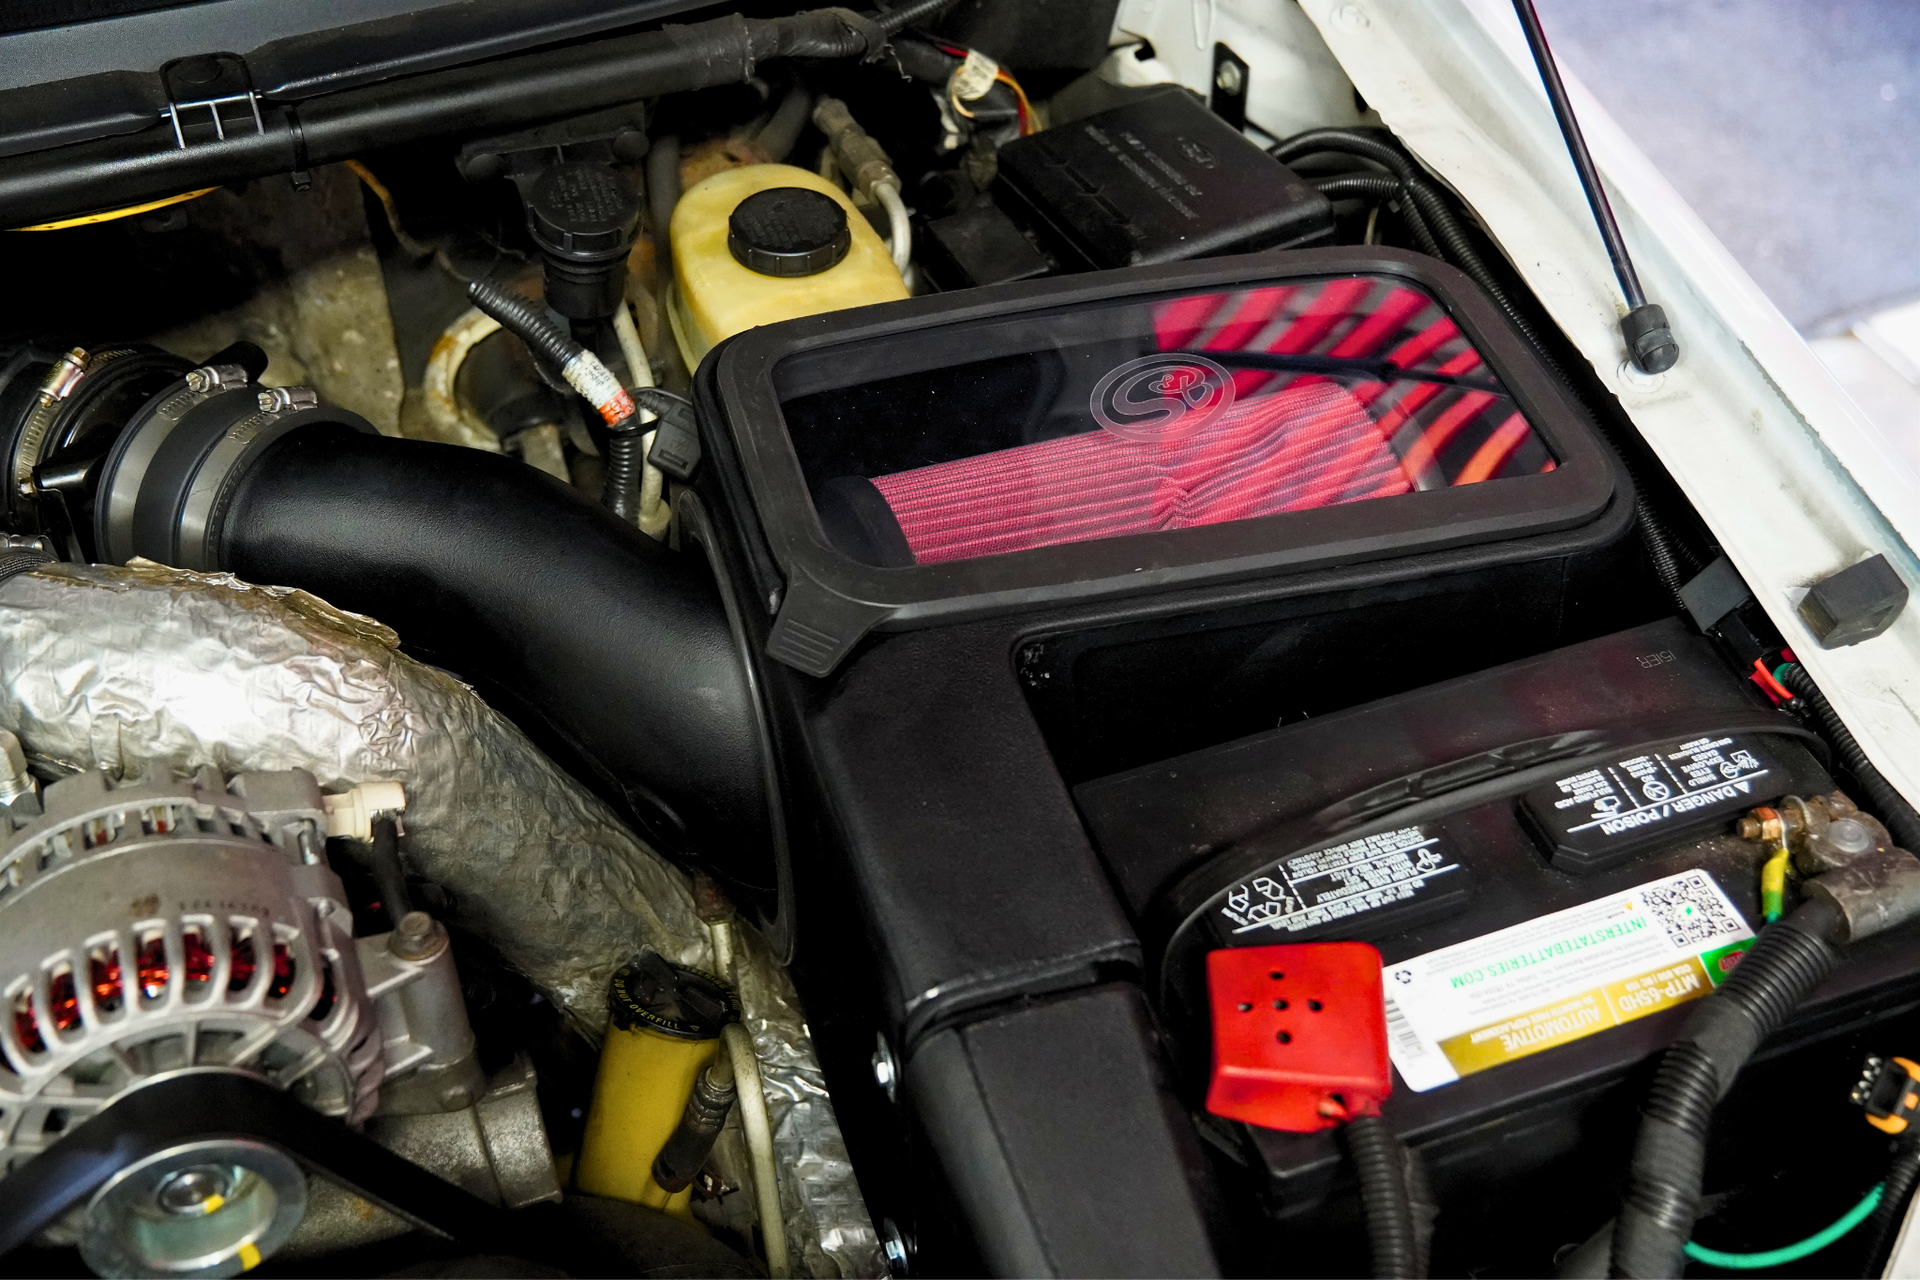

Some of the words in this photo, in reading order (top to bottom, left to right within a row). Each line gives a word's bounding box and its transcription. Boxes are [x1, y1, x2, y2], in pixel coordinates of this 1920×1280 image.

[1680, 755, 1724, 773] EXPLOSIVE
[1691, 749, 1719, 762] GASES
[1640, 774, 1655, 783] NO
[1688, 773, 1717, 786] SHIELD
[1689, 766, 1712, 778] EYES
[1554, 797, 1575, 809] ACID
[1573, 785, 1614, 803] SULFURIC
[1671, 785, 1737, 812] DANGER
[1600, 808, 1661, 834] POISON
[1371, 852, 1409, 868] MEDICAL
[1329, 868, 1351, 881] FAST
[1316, 881, 1369, 903] IMMEDIATELY
[1448, 915, 1648, 989] INTERSTATEBATTERIES.COM
[1615, 972, 1702, 1013] MTP-65HD
[616, 988, 633, 1002] NOT
[628, 1003, 680, 1029] OVERFILL
[1466, 1015, 1531, 1043] REPLACEMENT
[1497, 1004, 1604, 1052] AUTOMOTIVE
